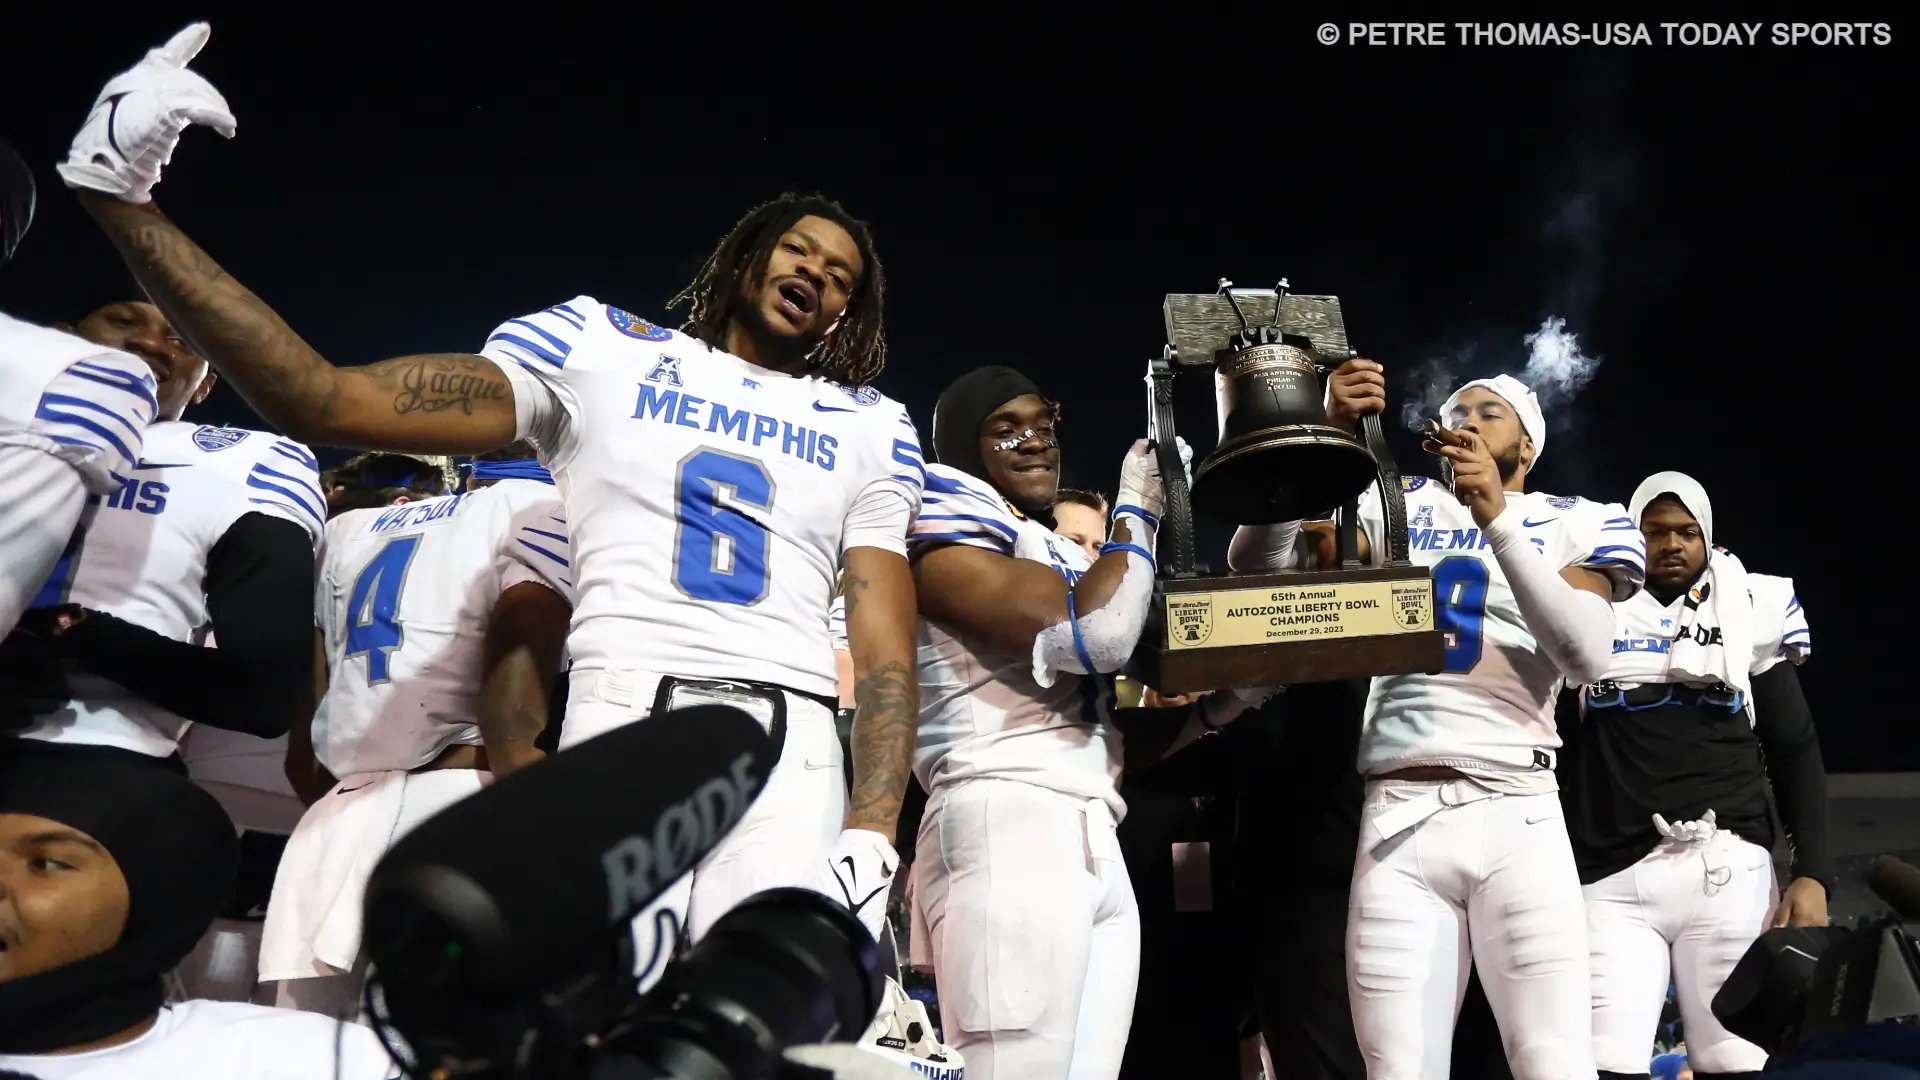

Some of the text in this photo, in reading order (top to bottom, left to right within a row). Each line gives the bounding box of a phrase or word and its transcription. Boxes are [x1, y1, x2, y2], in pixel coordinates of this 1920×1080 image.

[630, 383, 838, 471] MEMPHIS
[1000, 428, 1037, 450] PSALM
[670, 444, 778, 608] 6
[1271, 590, 1336, 602] 65th Annual
[1396, 594, 1427, 602] LIBERTY
[344, 532, 424, 688] 4
[1174, 608, 1209, 617] LIBERTY
[1226, 599, 1380, 618] AUTOZONE LIBERTY BOWL
[1400, 601, 1424, 611] BOWL
[1179, 615, 1205, 626] BOWL
[1269, 613, 1340, 626] CHAMPIONS
[1430, 555, 1490, 675] 9
[1266, 625, 1344, 638] December 29, 2023
